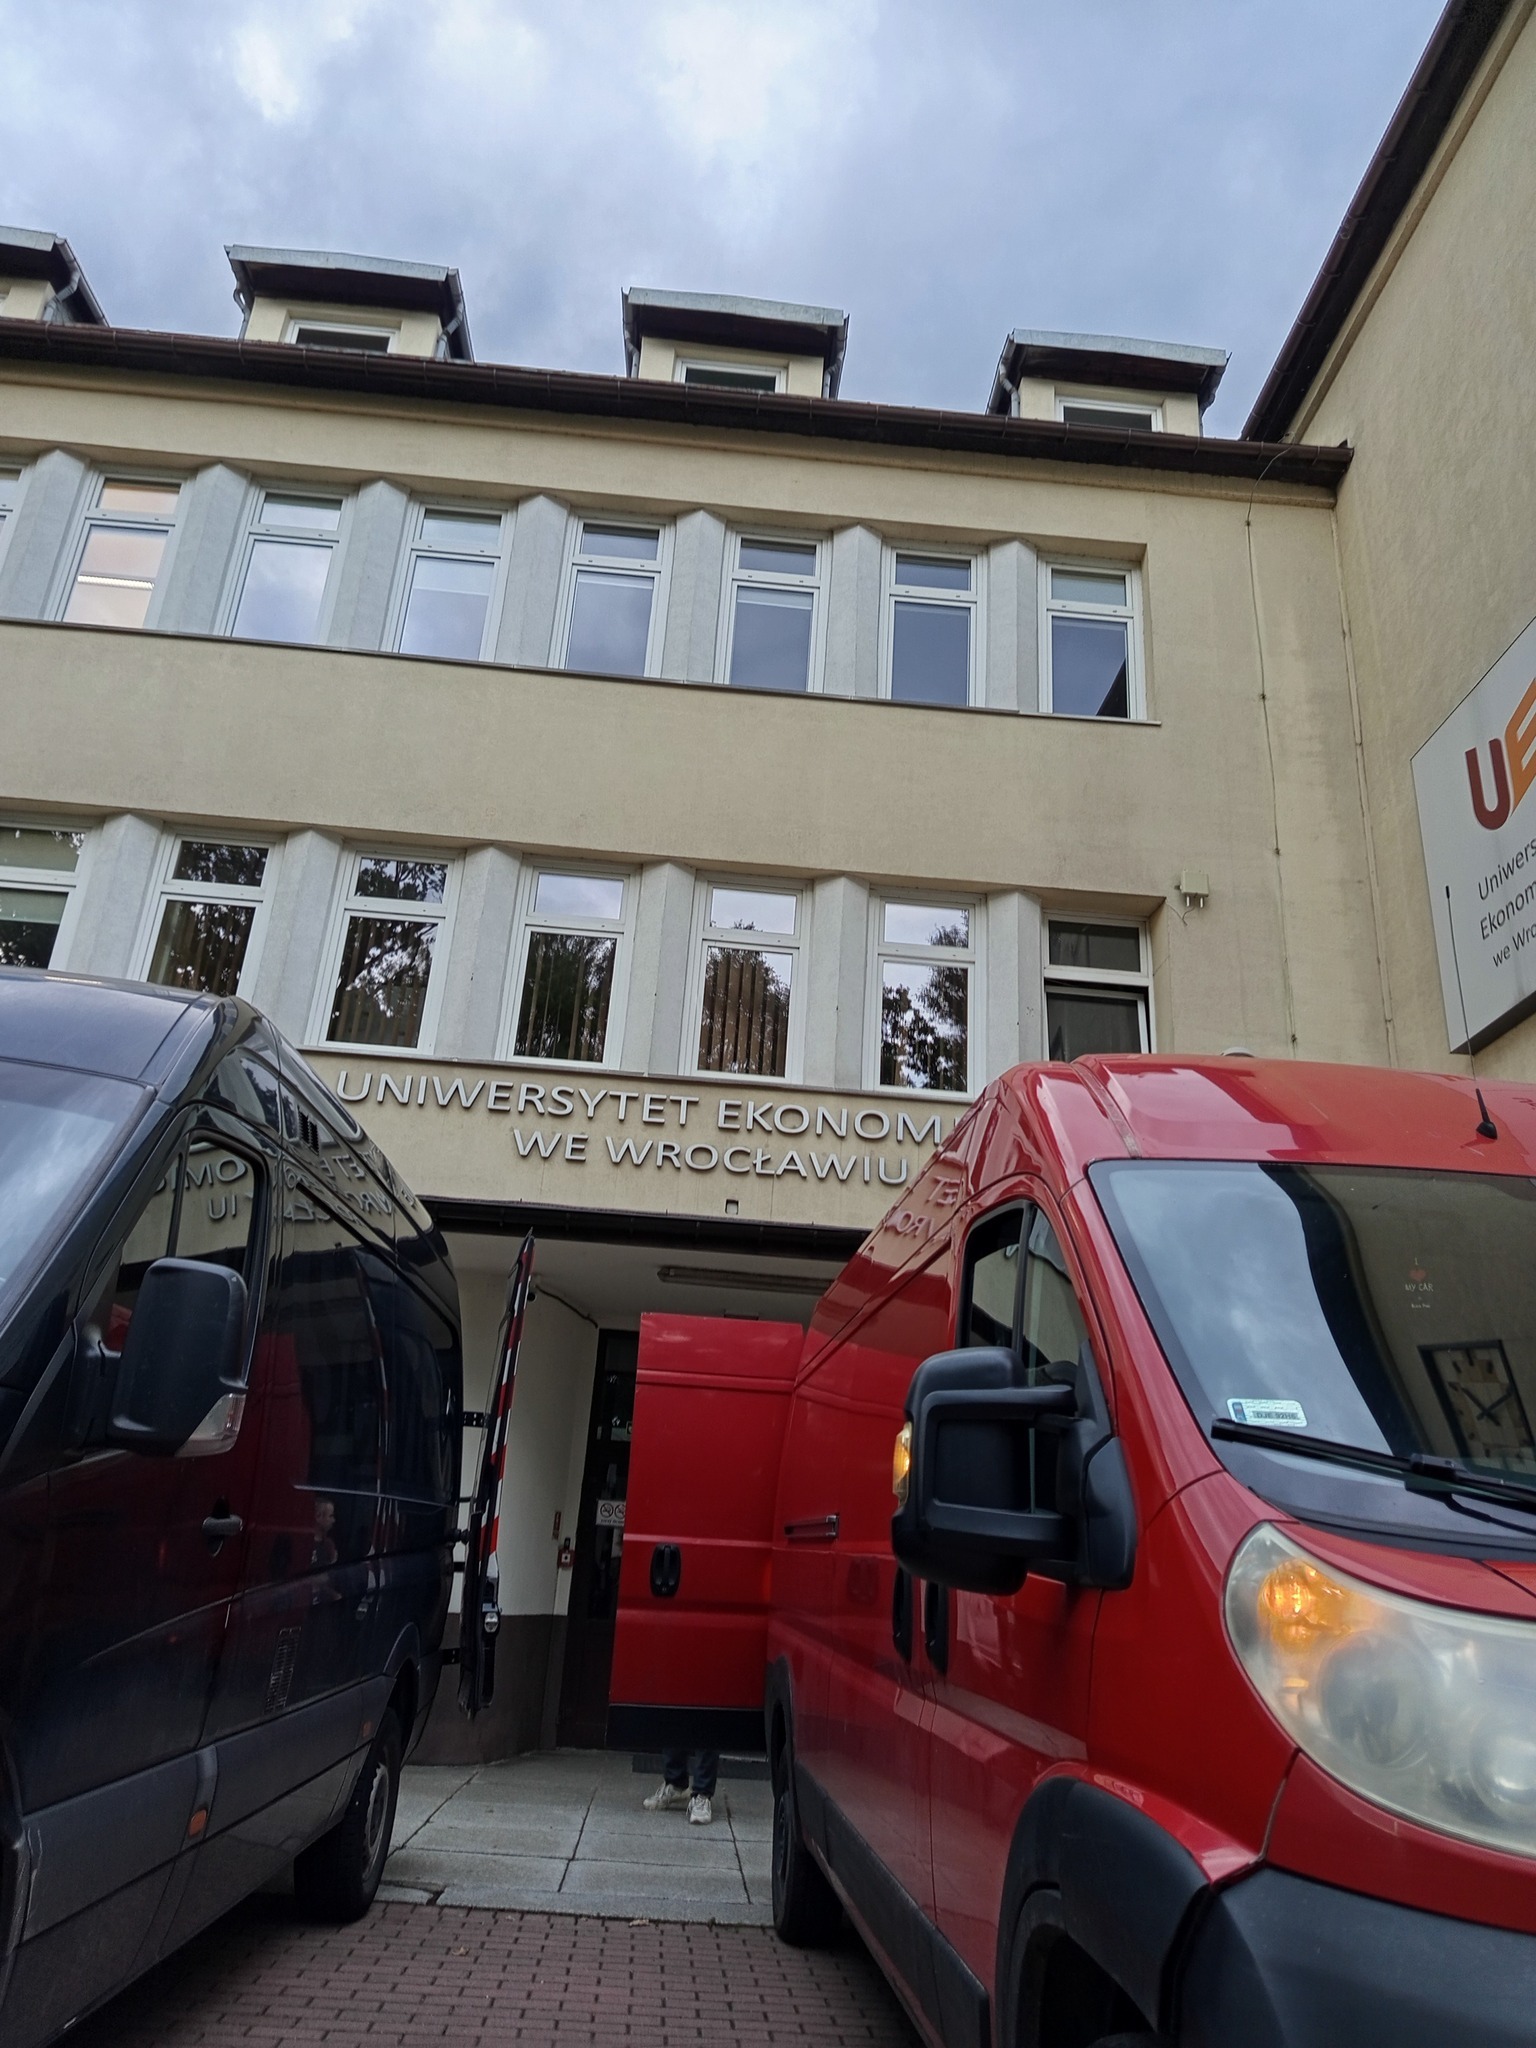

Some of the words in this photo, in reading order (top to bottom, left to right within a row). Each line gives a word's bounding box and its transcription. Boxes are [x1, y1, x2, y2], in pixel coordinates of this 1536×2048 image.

[1493, 945, 1511, 968] we
[336, 1070, 701, 1126] UNIWERSYTET
[717, 1099, 962, 1146] EKONOM
[513, 1129, 590, 1162] WE
[605, 1136, 909, 1185] WROCŁAWIU
[1404, 1282, 1417, 1292] MY
[1418, 1282, 1434, 1292] CAR
